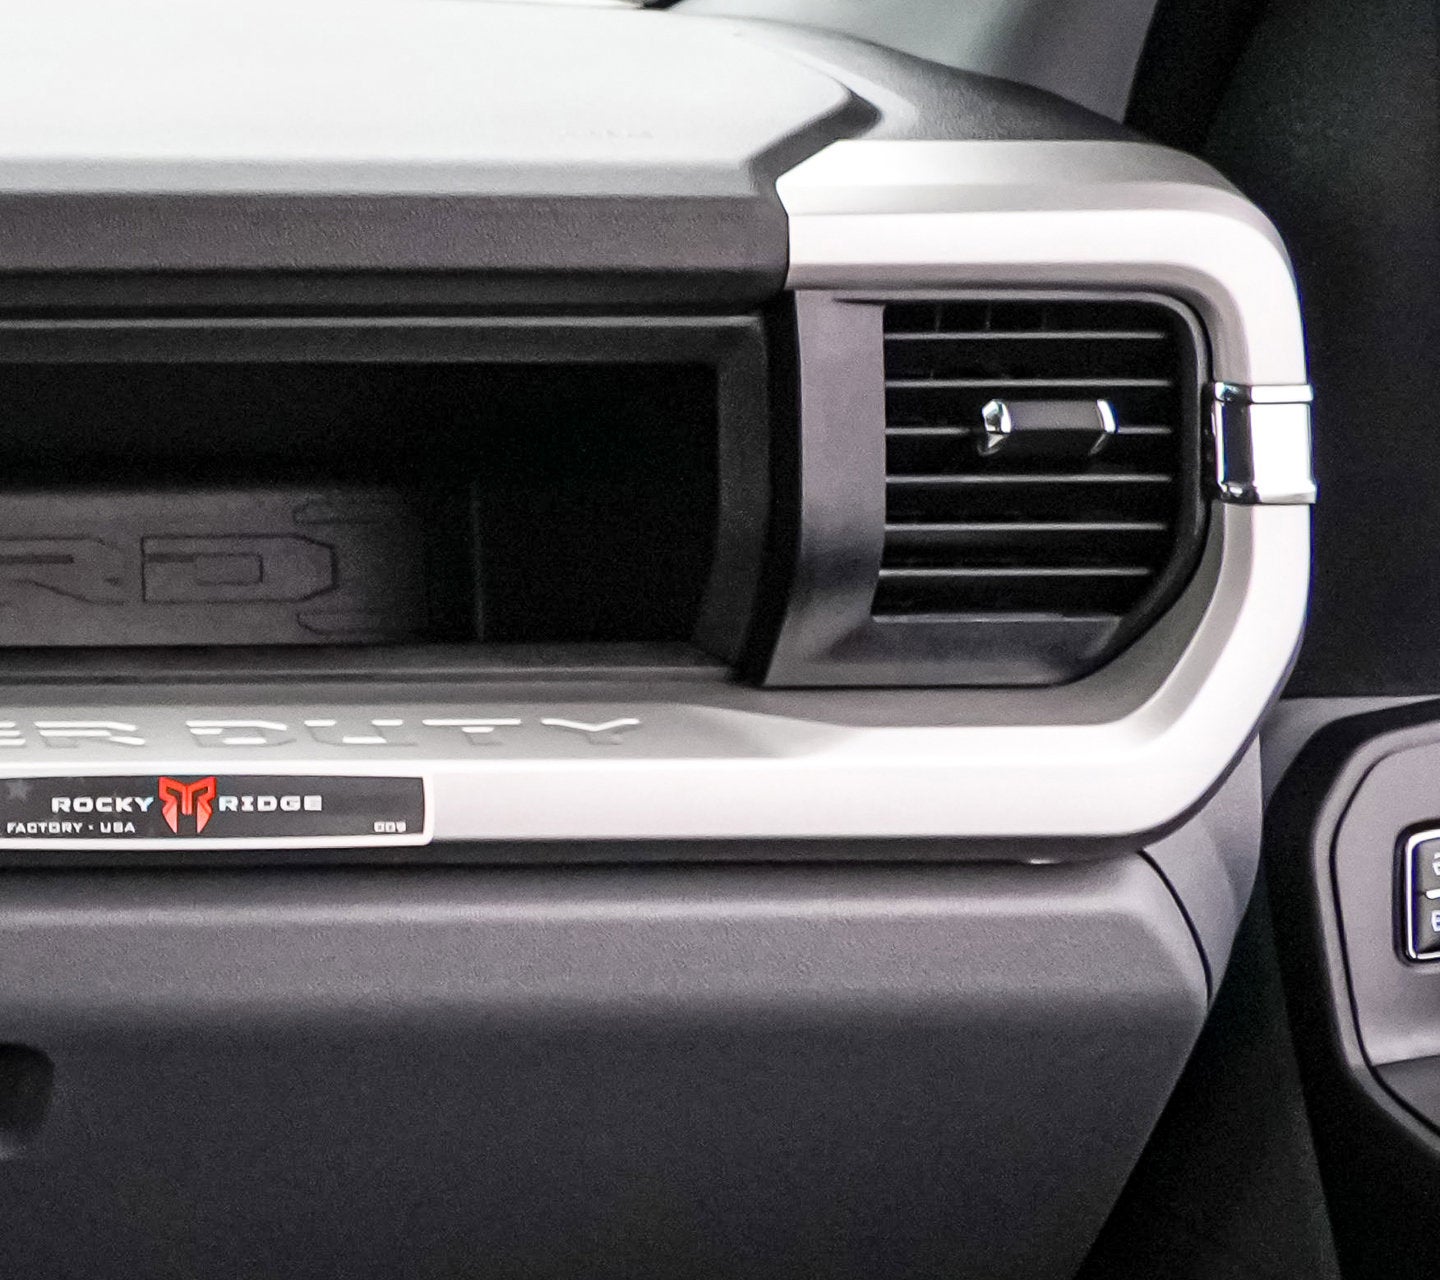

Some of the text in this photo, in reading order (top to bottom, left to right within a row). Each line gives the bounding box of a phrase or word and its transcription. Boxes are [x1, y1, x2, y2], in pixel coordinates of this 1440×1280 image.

[185, 717, 641, 747] DUTY
[51, 794, 324, 814] ROCKY RIDGE
[6, 821, 83, 835] FACTORY
[100, 821, 136, 835] USA
